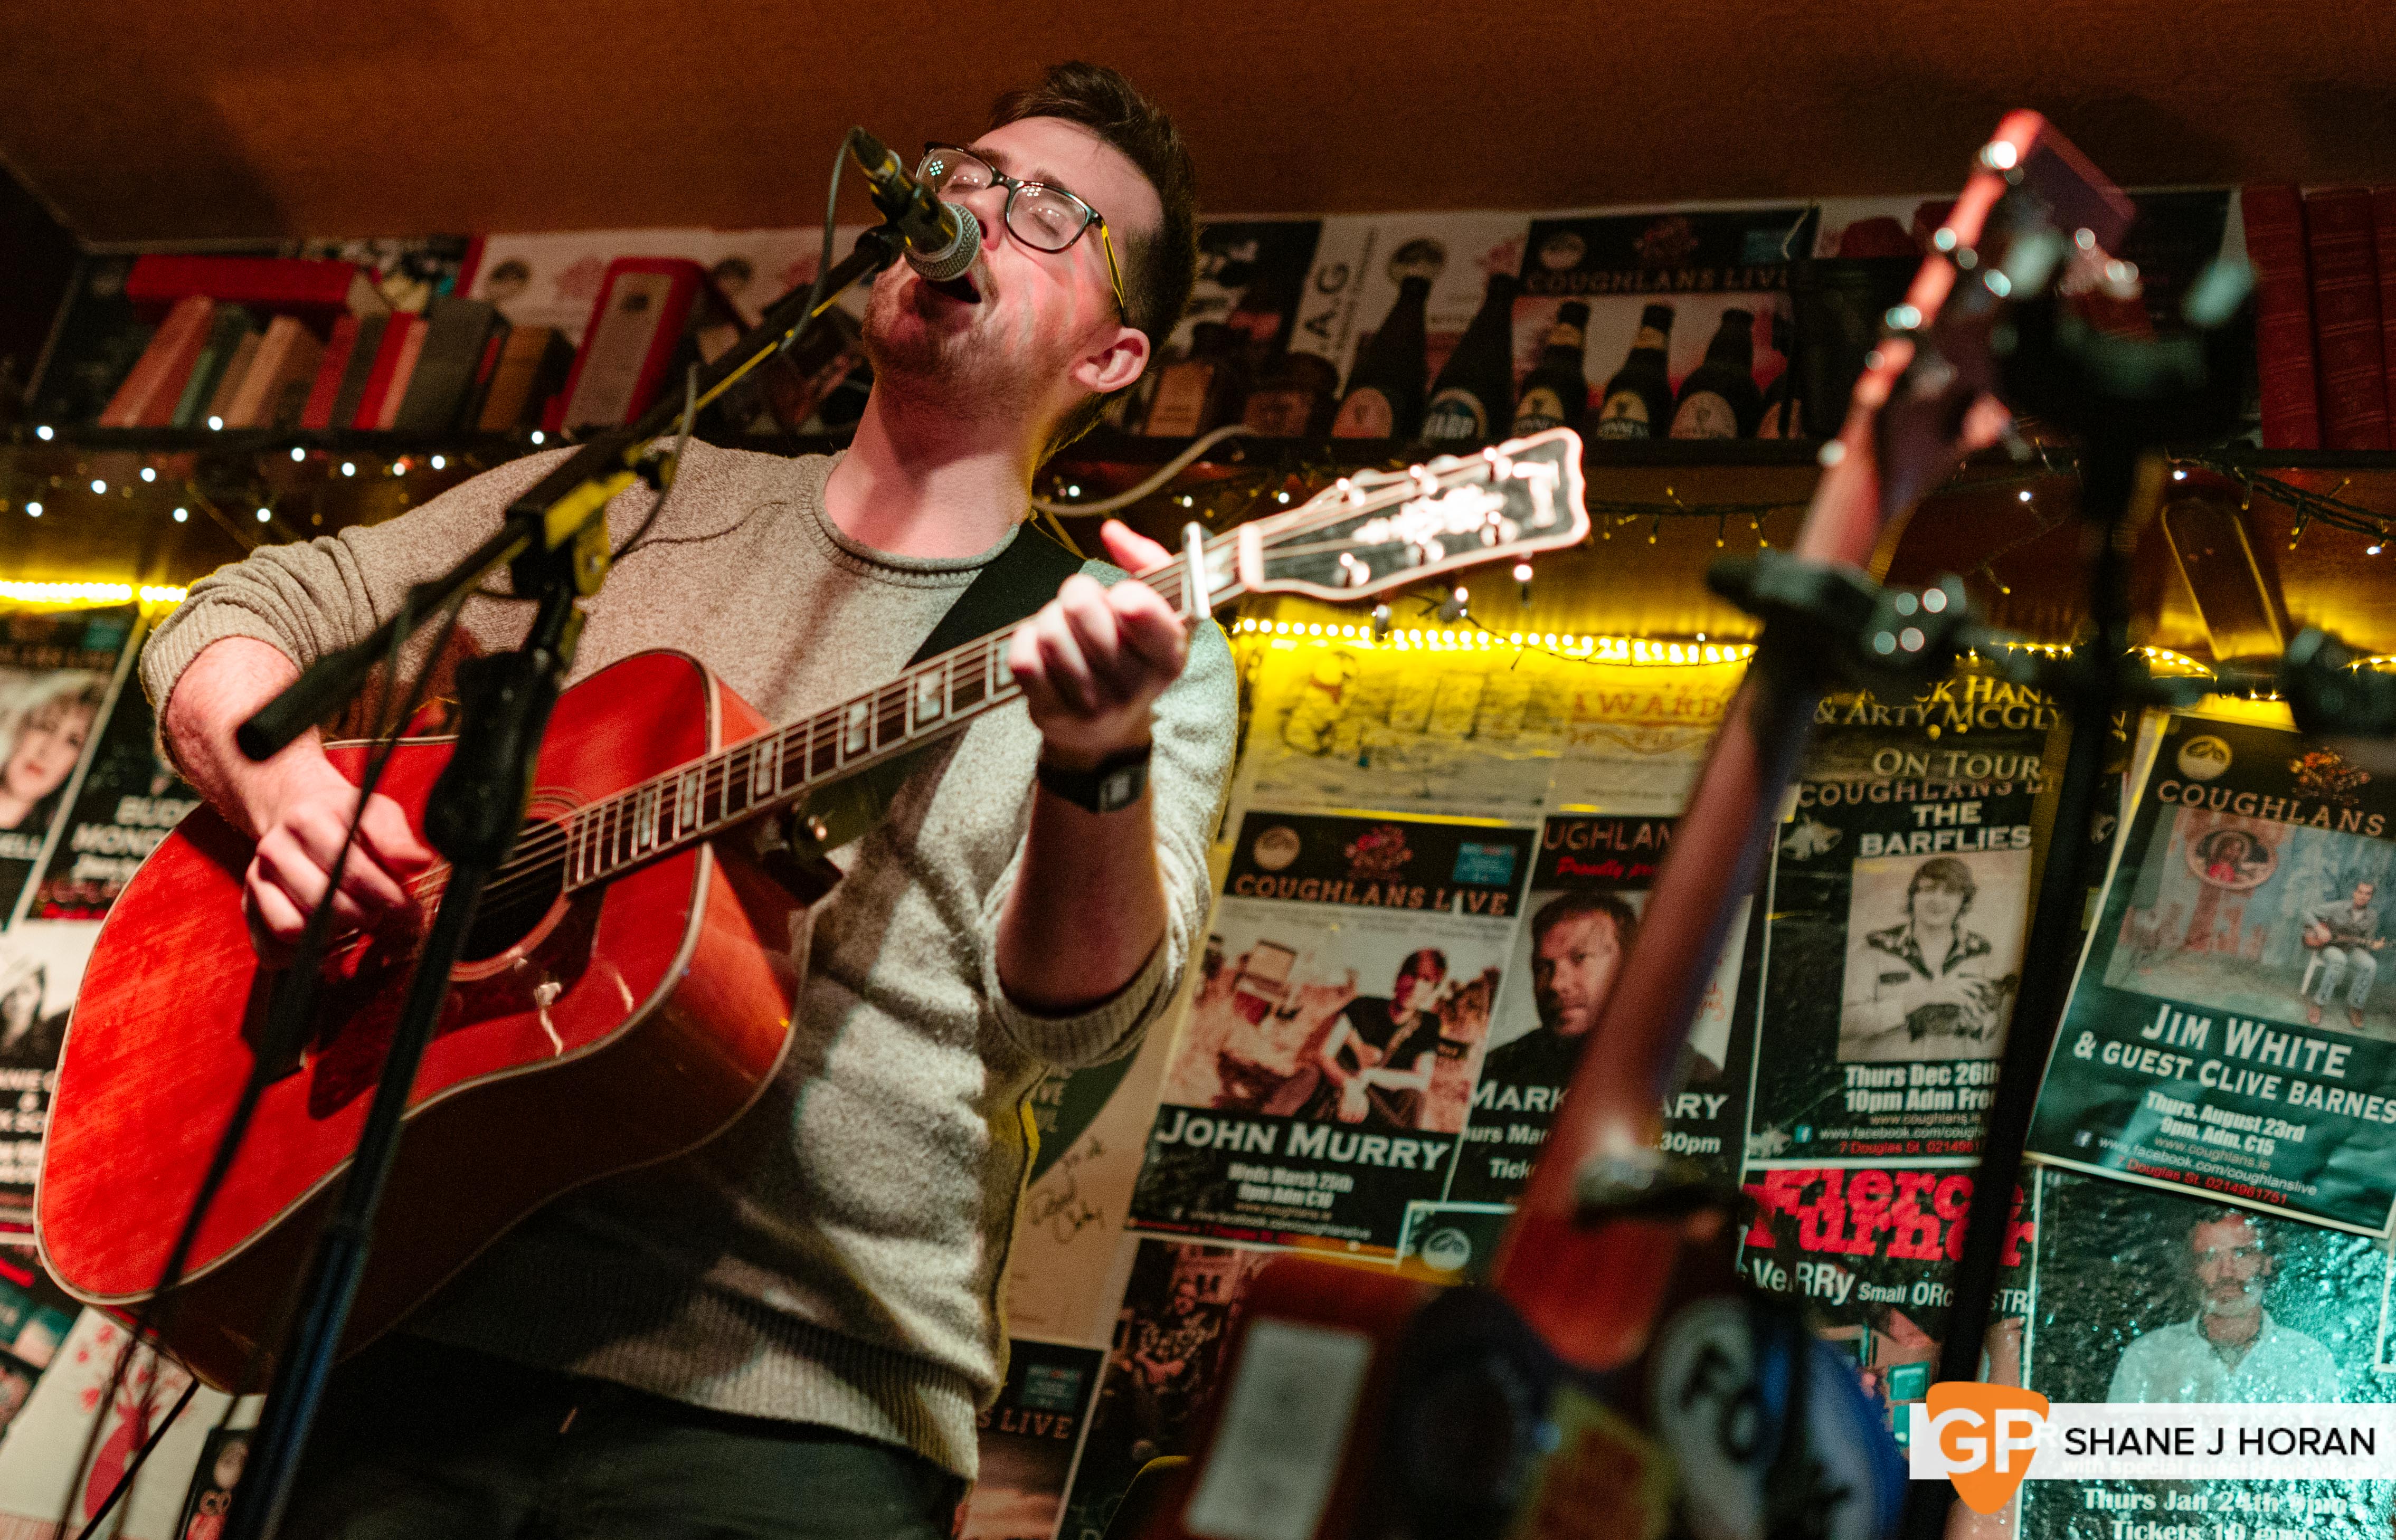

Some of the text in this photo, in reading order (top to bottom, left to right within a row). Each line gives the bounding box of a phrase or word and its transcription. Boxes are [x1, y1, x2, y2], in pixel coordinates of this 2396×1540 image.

[1526, 268, 1715, 293] COUGHLANS
[1965, 676, 2057, 705] HAN
[1814, 696, 1837, 725] &
[1912, 801, 1983, 827] THE
[2158, 780, 2386, 836] COUGHLANS
[1860, 825, 2031, 858] BARFLIES
[1234, 873, 1510, 915] COUGHLANS LIVE
[2142, 1003, 2352, 1078] JIM WHITE
[1846, 1064, 1906, 1088] Thurs
[1909, 1062, 1952, 1086] Dec
[2073, 1031, 2396, 1124] & GUEST CLIVE BARNES
[1845, 1089, 1901, 1113] 10pm
[1906, 1089, 1955, 1111] Adm
[2199, 1104, 2261, 1133] August
[2262, 1118, 2307, 1143] 23rd
[1154, 1109, 1451, 1171] JOHN MURRY
[2126, 1157, 2181, 1181] Douglas
[1857, 1281, 1908, 1304] Small
[1000, 1407, 1073, 1439] LIVE
[2083, 1487, 2156, 1510] Thurs
[2163, 1489, 2208, 1512] Jan
[2218, 1490, 2279, 1513] 24th
